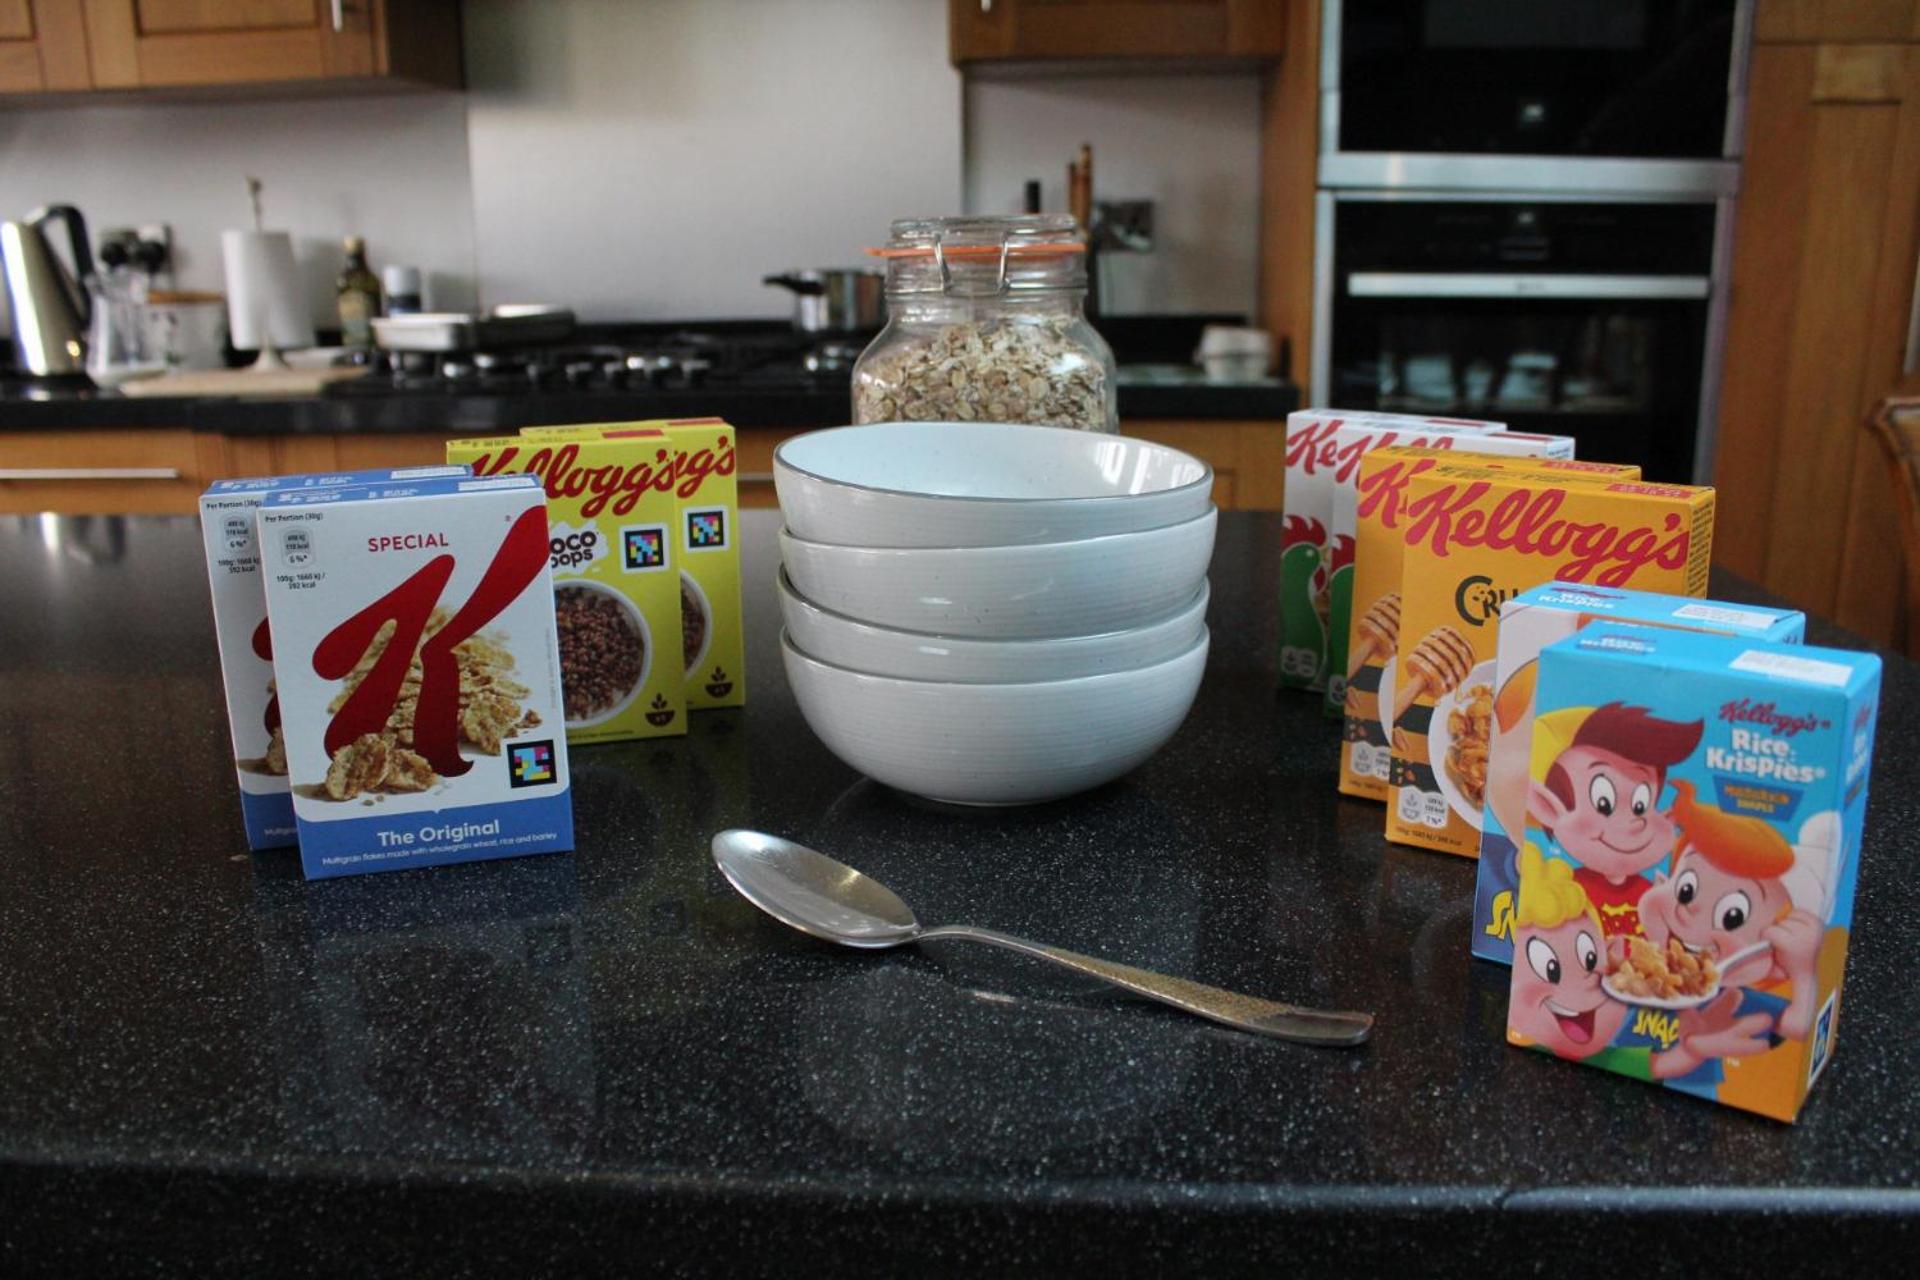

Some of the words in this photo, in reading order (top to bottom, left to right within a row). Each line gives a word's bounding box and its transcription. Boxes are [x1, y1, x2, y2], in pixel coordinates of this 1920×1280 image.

[471, 444, 676, 518] Kllogg's
[278, 514, 304, 522] Portion
[368, 533, 449, 552] SPECIAL
[550, 531, 597, 555] oco
[1404, 482, 1690, 587] Kellogg's
[1731, 728, 1791, 757] Rice
[1706, 746, 1816, 784] Krispies
[377, 831, 416, 847] The
[419, 819, 500, 842] Original
[387, 850, 410, 858] made
[515, 834, 531, 844] and
